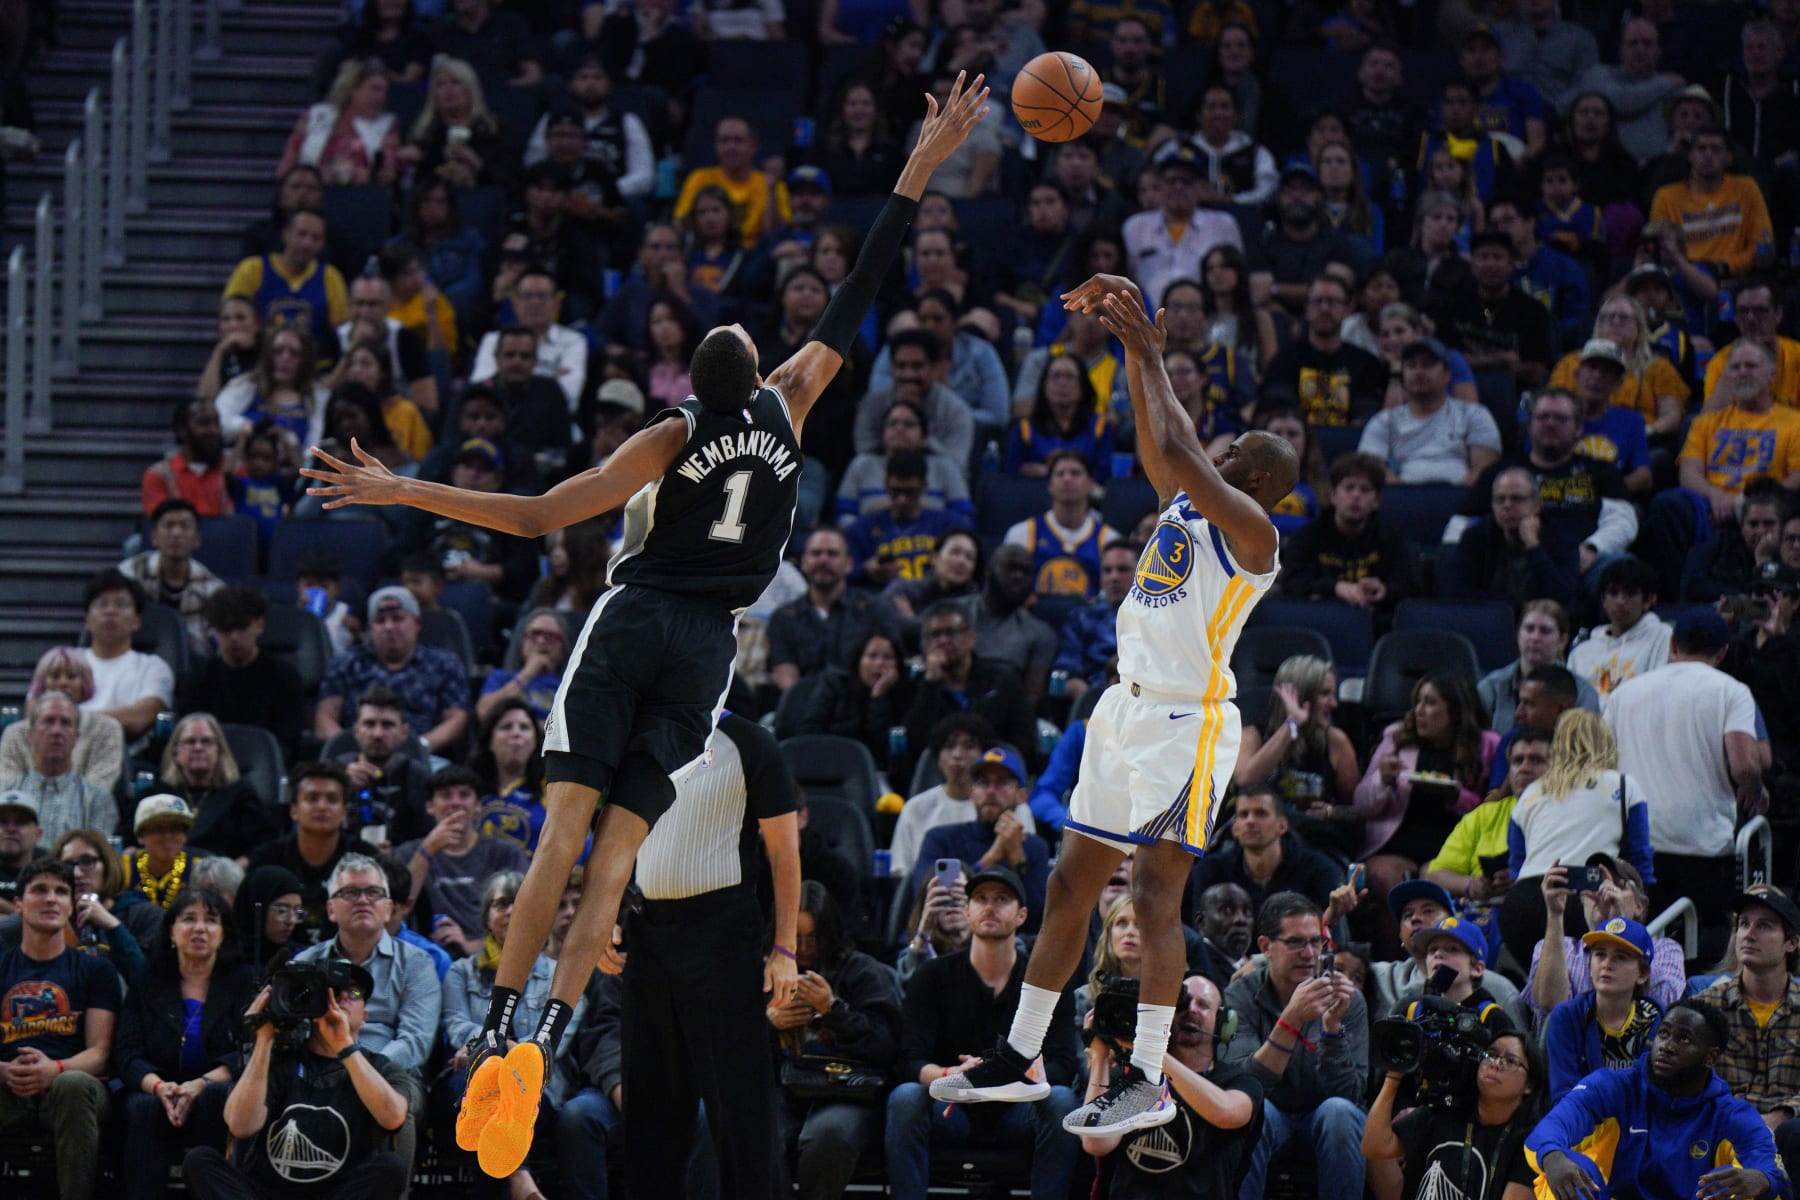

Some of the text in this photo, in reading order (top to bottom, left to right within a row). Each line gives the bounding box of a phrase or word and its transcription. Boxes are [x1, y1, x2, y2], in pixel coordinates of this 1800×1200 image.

[677, 430, 798, 484] WEMBANYAMA
[708, 470, 754, 544] 1
[1169, 541, 1186, 564] 3
[1130, 586, 1188, 609] ARRIORS
